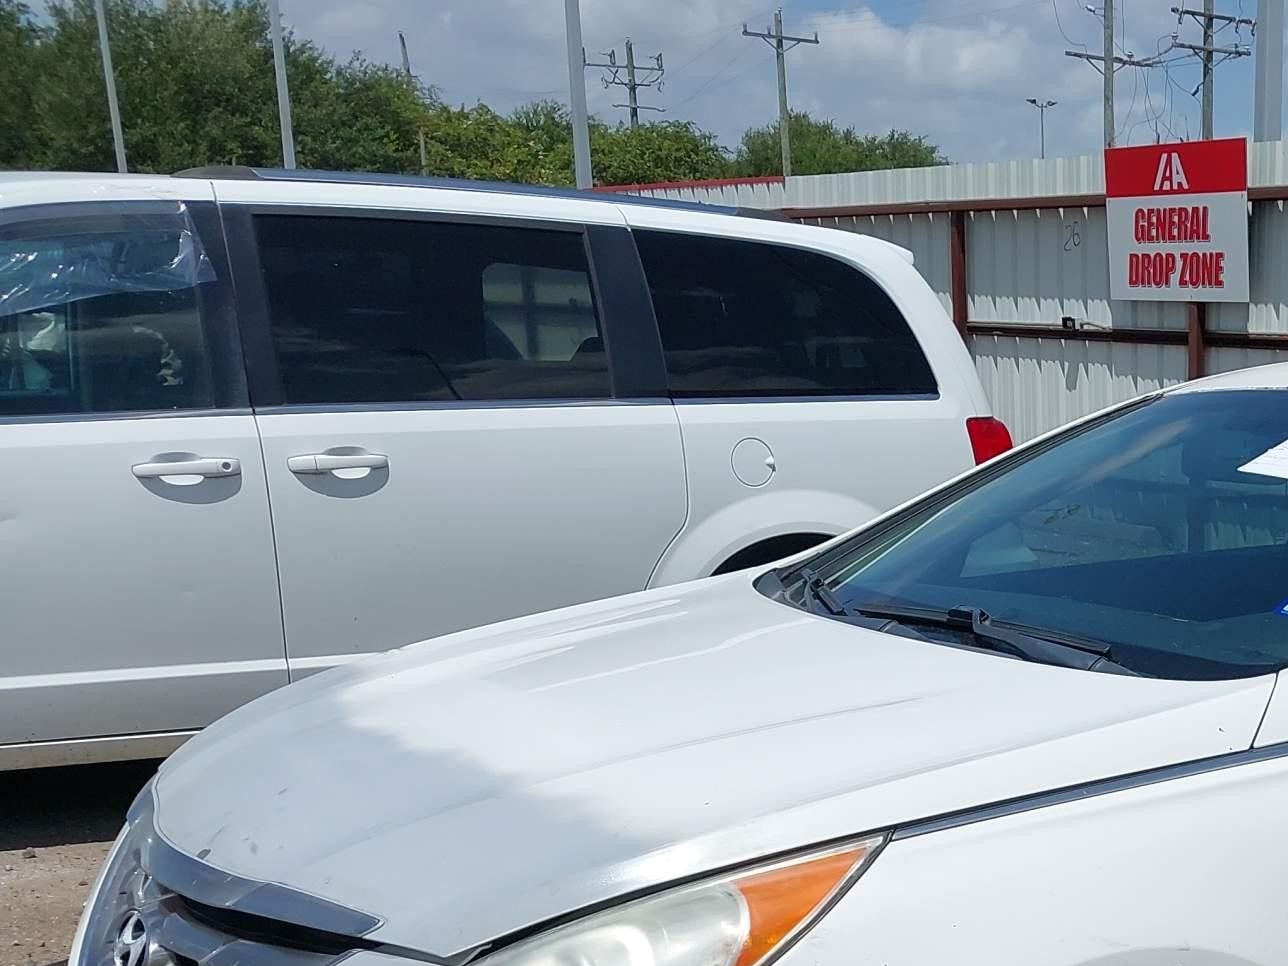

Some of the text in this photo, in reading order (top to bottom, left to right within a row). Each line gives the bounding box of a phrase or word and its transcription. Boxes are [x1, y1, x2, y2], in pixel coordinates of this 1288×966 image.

[1134, 206, 1211, 244] GENERAL
[1128, 252, 1225, 289] DROP ZONE
